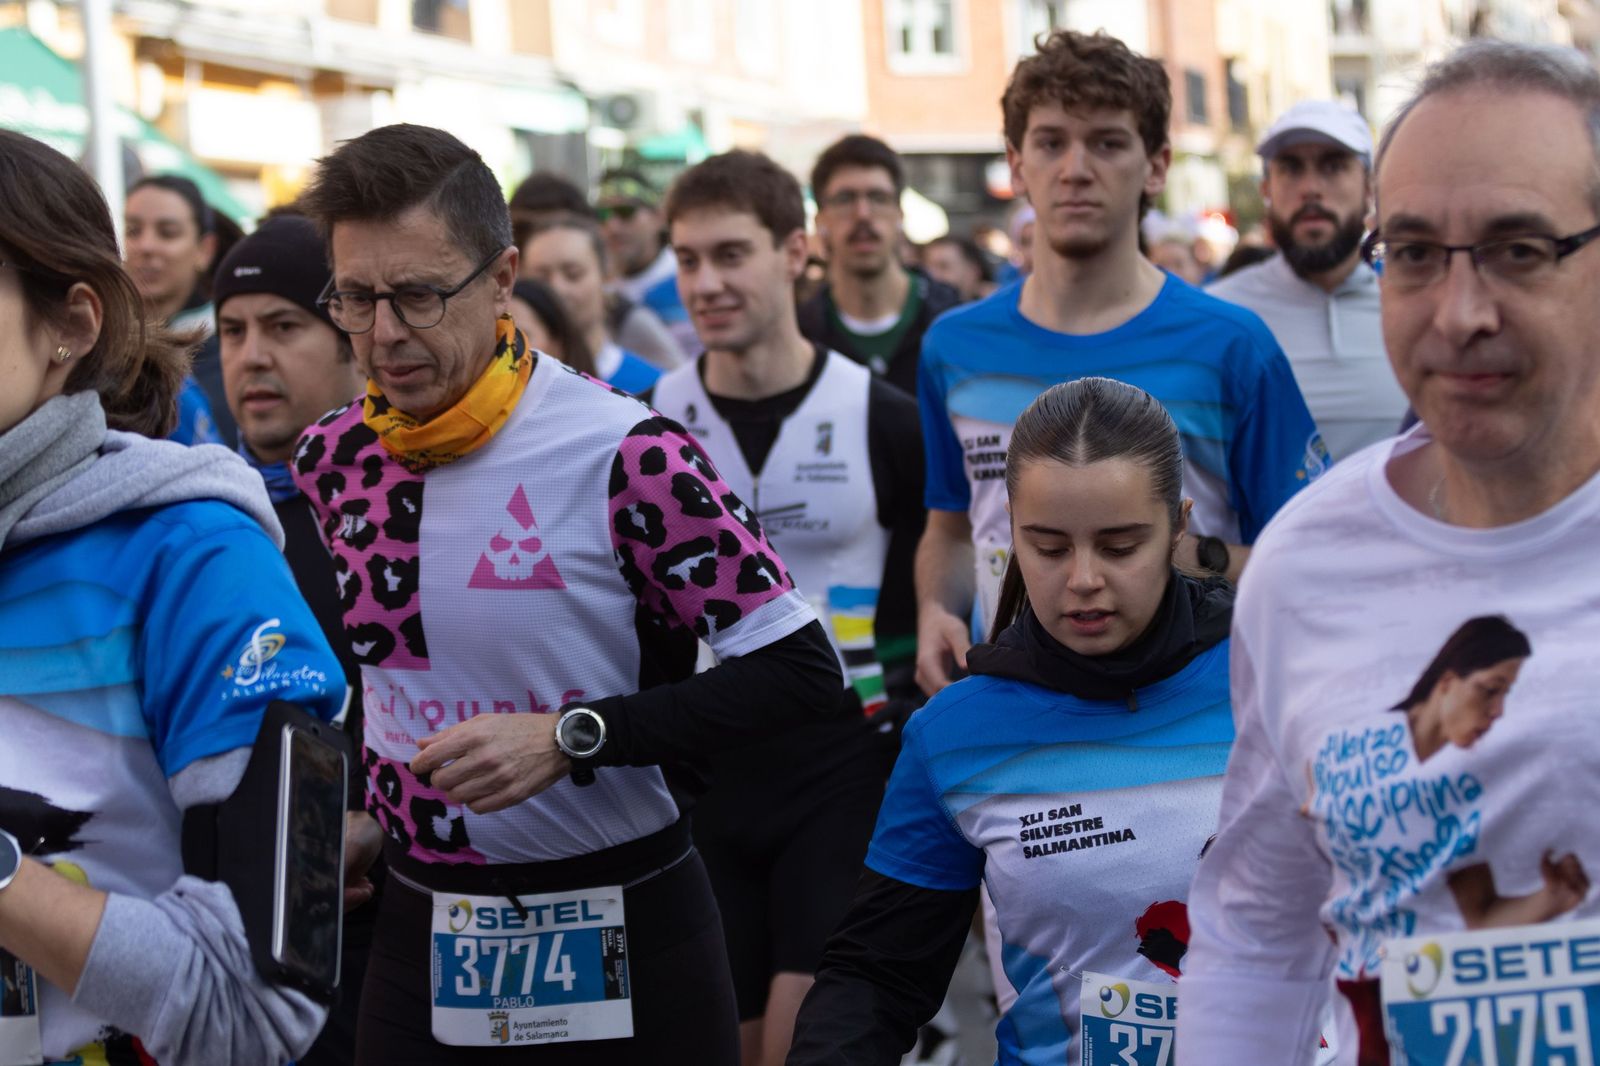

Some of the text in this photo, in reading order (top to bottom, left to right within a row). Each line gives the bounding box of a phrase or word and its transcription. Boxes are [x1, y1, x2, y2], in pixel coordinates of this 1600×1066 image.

[1019, 803, 1083, 828] XLI SAN
[1020, 816, 1104, 842] SILVESTRE
[1023, 828, 1136, 859] SALMANTINA
[475, 899, 604, 930] SETEL
[616, 933, 625, 953] 3774
[455, 932, 577, 997] 3774
[1452, 937, 1600, 984] SETE
[493, 995, 535, 1009] PABLO
[512, 1018, 568, 1031] Ayuntamiento
[514, 1030, 569, 1042] de Salamanca
[1431, 989, 1594, 1066] 2179
